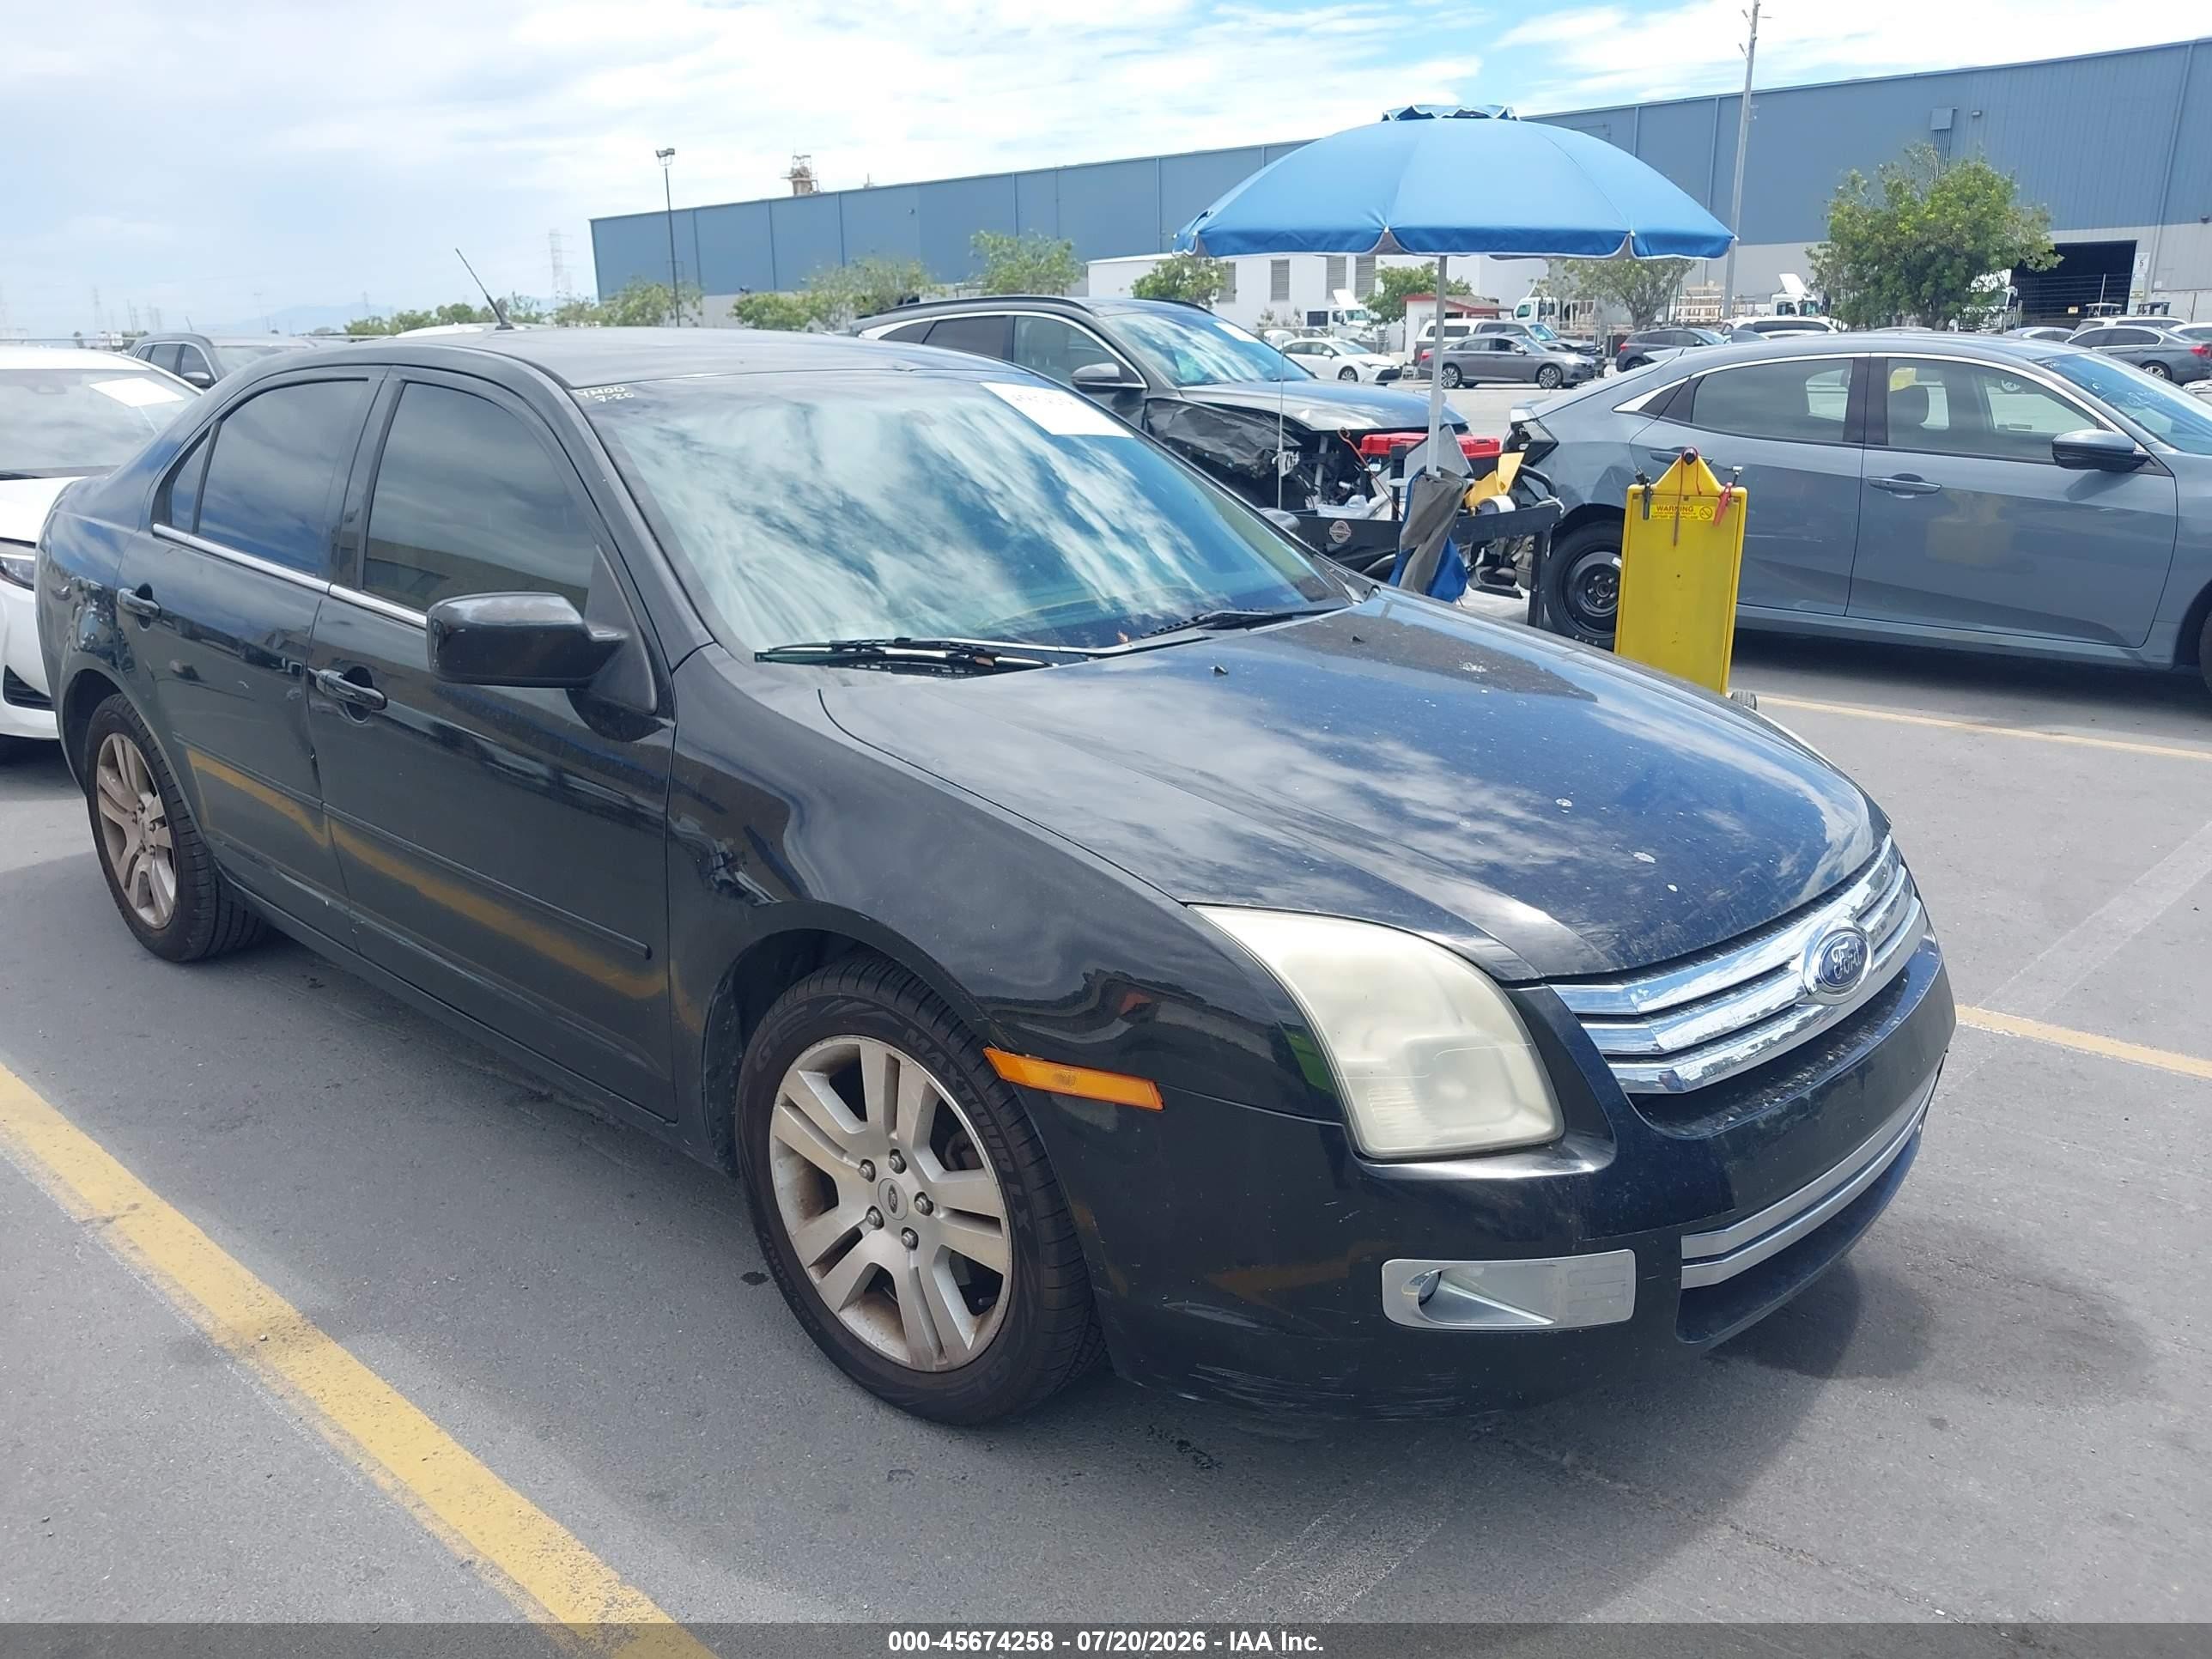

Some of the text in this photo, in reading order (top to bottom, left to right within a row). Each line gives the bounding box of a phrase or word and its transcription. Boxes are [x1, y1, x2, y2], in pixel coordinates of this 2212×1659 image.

[1831, 940, 1862, 980] Ford
[902, 1027, 1031, 1231] MAXTOUR LX
